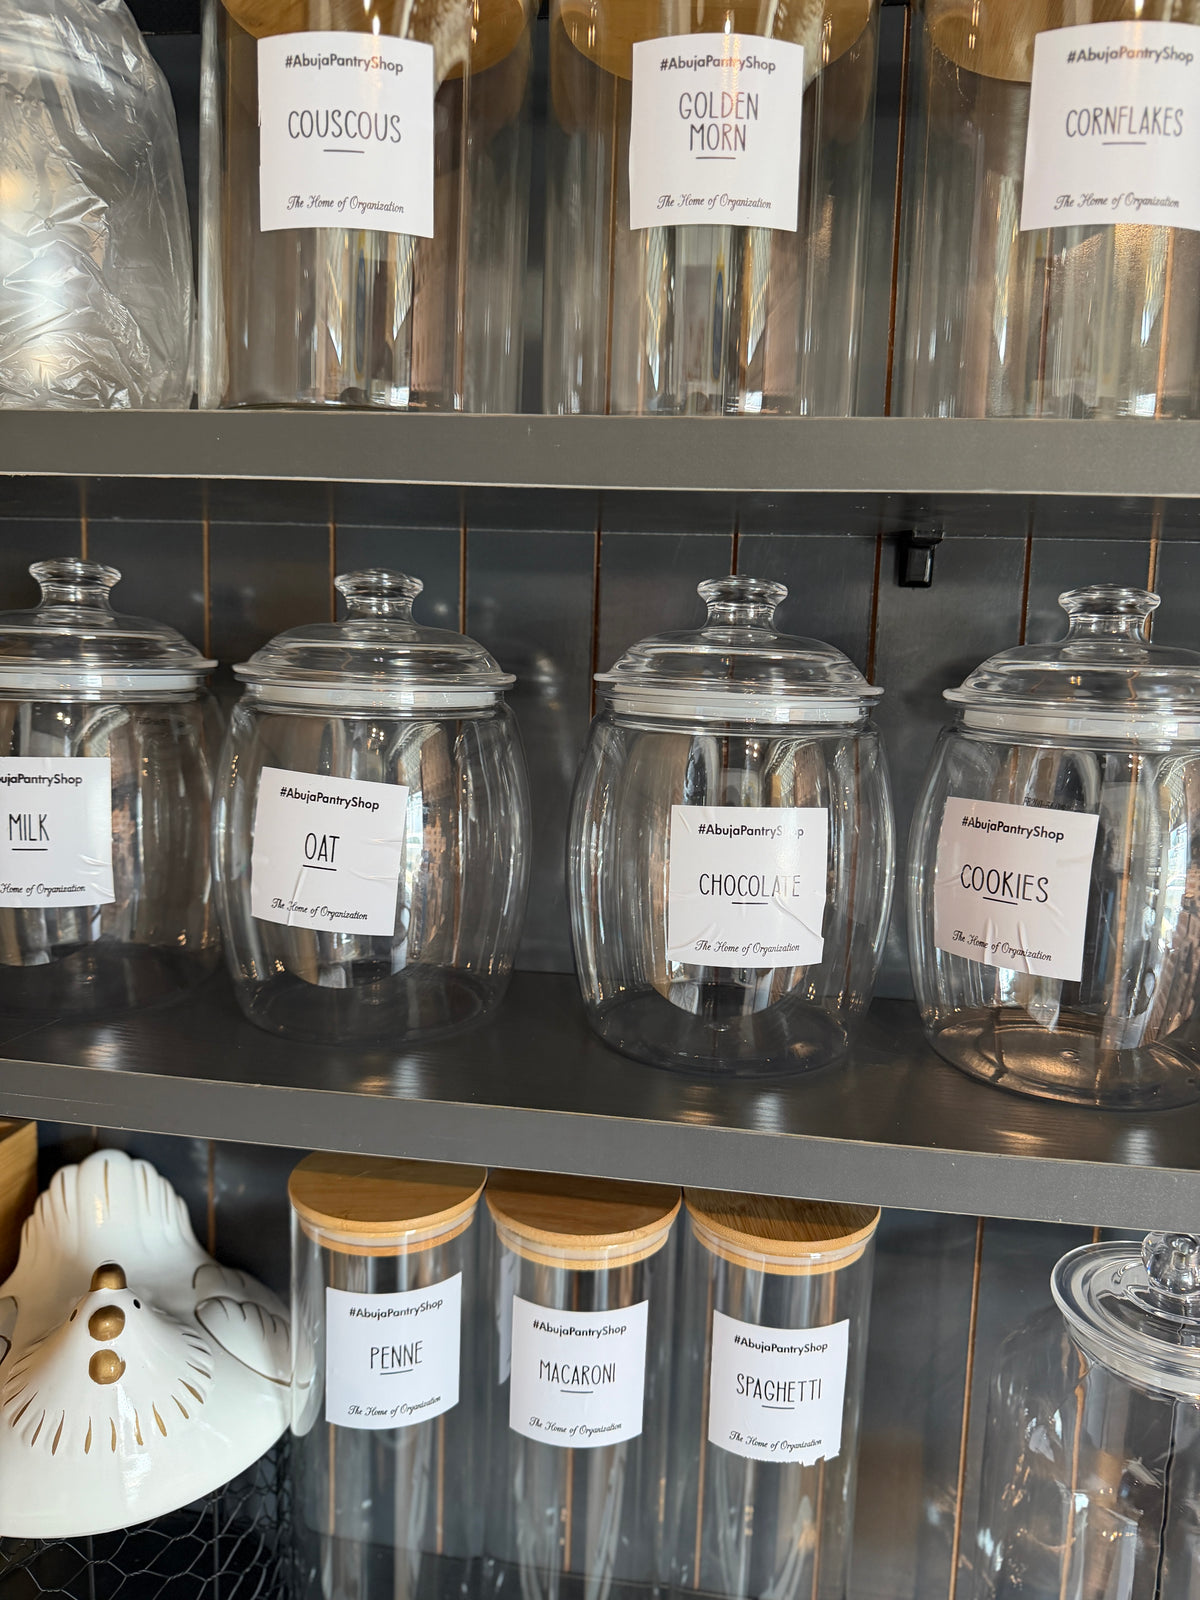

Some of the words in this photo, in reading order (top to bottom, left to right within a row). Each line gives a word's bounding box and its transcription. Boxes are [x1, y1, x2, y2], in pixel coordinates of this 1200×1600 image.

[284, 52, 404, 76] #AbujaPantryShop
[1066, 45, 1194, 67] #AbujaPantryShop
[679, 90, 760, 121] GOLDEN
[287, 108, 402, 144] COUSCOUS
[1065, 105, 1184, 138] CORNFLAKES
[689, 122, 747, 152] MORN
[286, 194, 305, 211] The
[306, 194, 335, 210] Home
[337, 196, 350, 213] of
[349, 195, 405, 215] Organization
[656, 194, 675, 210] The
[677, 193, 705, 208] Home
[708, 194, 720, 210] of
[719, 192, 772, 212] Organization
[1053, 194, 1075, 211] The
[1076, 192, 1109, 209] Home
[1111, 192, 1126, 211] of
[1124, 191, 1180, 212] Organization
[0, 772, 84, 788] ujaPantryShop
[279, 786, 380, 813] #AbujaPantryShop
[8, 813, 50, 842] MILK
[697, 823, 805, 840] #AbujaPantrySp
[961, 815, 1066, 844] #AbujaPantryShop
[304, 832, 341, 864] OAT
[0, 882, 24, 895] Home
[25, 883, 37, 898] of
[36, 883, 87, 898] Organization
[698, 872, 801, 898] CHOCOLATE
[959, 863, 1050, 904] COOKIES
[270, 897, 286, 910] The
[286, 900, 309, 915] Home
[309, 905, 320, 919] of
[319, 905, 369, 921] Organization
[694, 939, 712, 952] The
[713, 940, 740, 953] Home
[741, 942, 754, 957] of
[752, 941, 801, 958] Organization
[952, 929, 967, 943] The
[966, 933, 989, 949] Home
[990, 941, 1002, 955] of
[1000, 942, 1053, 963] Organization
[349, 1298, 444, 1322] #AbujaPantryShop
[532, 1318, 628, 1339] #AbujaPantryShop
[369, 1339, 424, 1371] PENNE
[733, 1334, 829, 1357] #AbujaPantryShop
[538, 1358, 617, 1387] MACARONI
[735, 1372, 823, 1403] SPAGHETTI
[347, 1404, 363, 1417] The
[364, 1406, 389, 1417] Home
[389, 1404, 400, 1419] of
[400, 1394, 442, 1417] Organization
[528, 1416, 544, 1428] The
[544, 1420, 568, 1434] Home
[568, 1425, 580, 1438] of
[578, 1421, 623, 1438] Organization
[728, 1430, 744, 1443] The
[744, 1435, 769, 1449] Home
[769, 1441, 781, 1453] of
[780, 1438, 823, 1454] Organization
